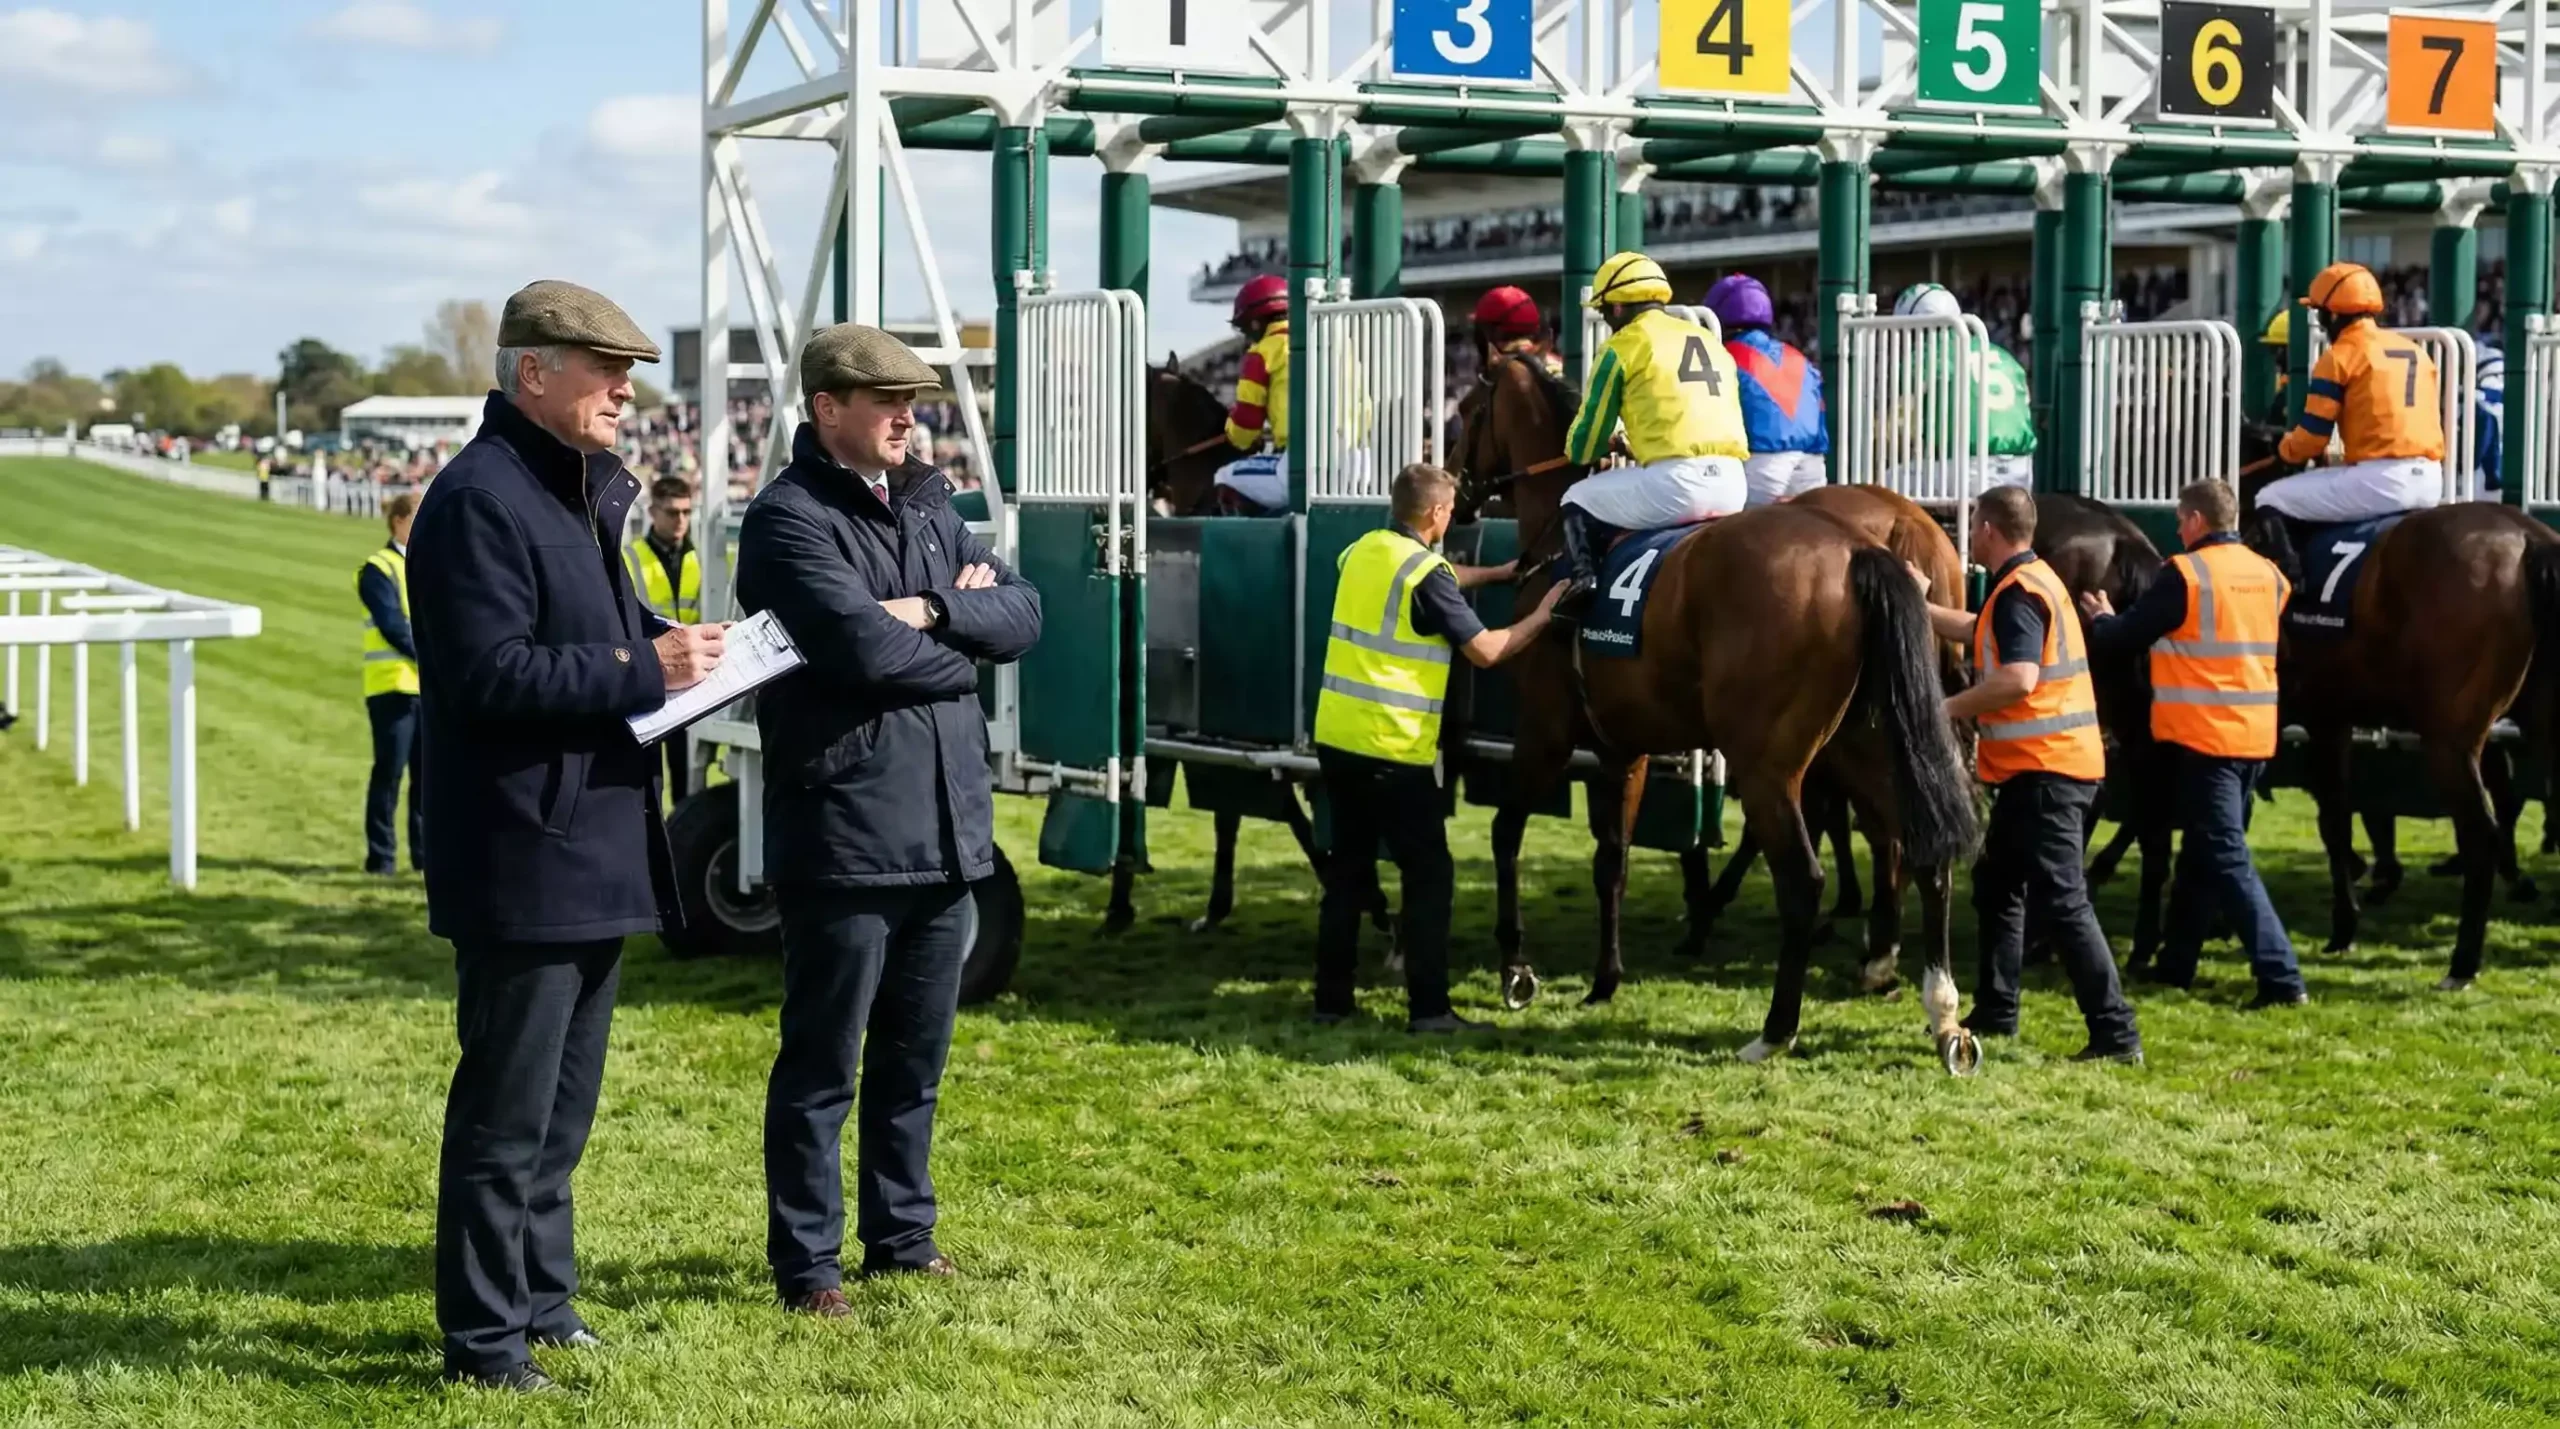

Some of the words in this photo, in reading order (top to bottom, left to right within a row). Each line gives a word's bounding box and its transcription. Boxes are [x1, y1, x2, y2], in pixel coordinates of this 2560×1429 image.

[1432, 0, 1493, 64] 3
[1696, 0, 1754, 75] 4
[1952, 2, 2007, 92] 5
[2191, 18, 2243, 106] 6
[2421, 35, 2464, 115] 7
[1677, 335, 1722, 397] 4
[2384, 349, 2418, 407] 7
[1609, 548, 1659, 617] 4
[2319, 540, 2367, 603] 7
